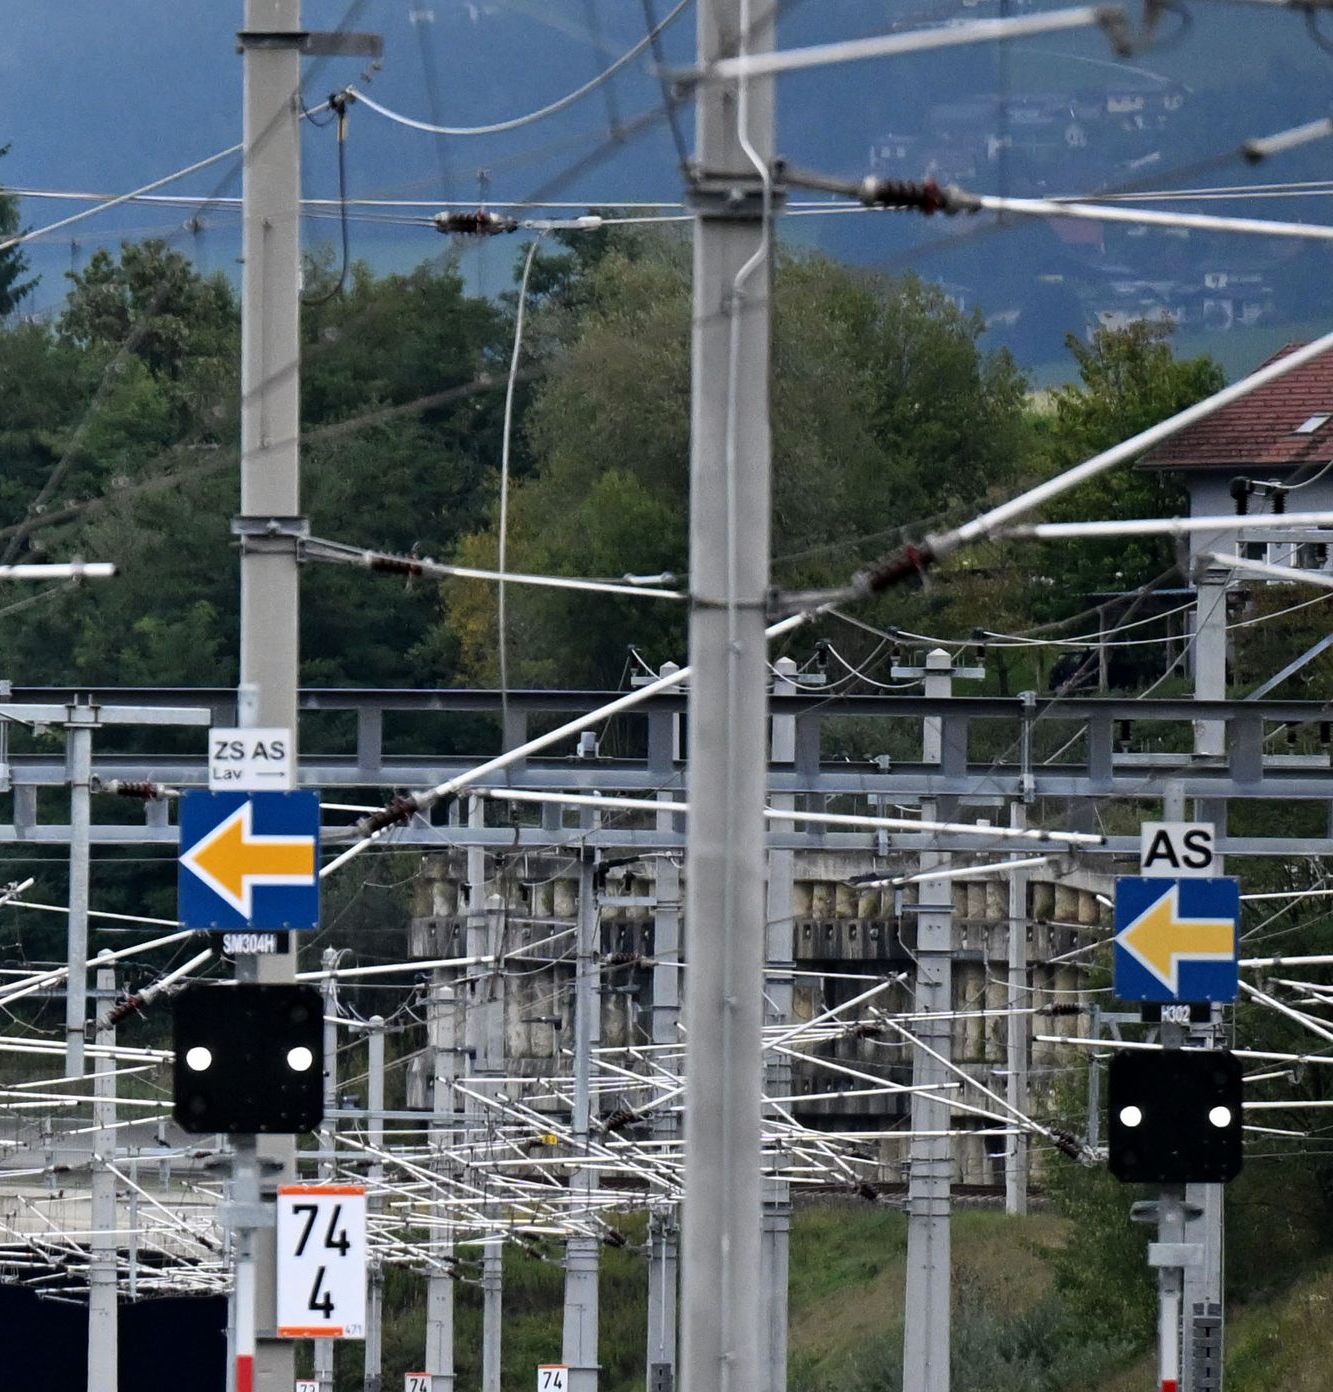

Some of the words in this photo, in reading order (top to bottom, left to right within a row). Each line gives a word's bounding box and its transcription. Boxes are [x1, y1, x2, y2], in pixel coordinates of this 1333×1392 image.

[214, 741, 245, 761] ZS
[251, 741, 286, 761] AS
[213, 767, 242, 780] Lav
[1144, 829, 1213, 869] AS
[223, 934, 275, 953] SM304H
[1161, 1005, 1190, 1023] H302
[292, 1204, 351, 1257] 74
[308, 1266, 335, 1319] 4
[543, 1371, 563, 1389] 74
